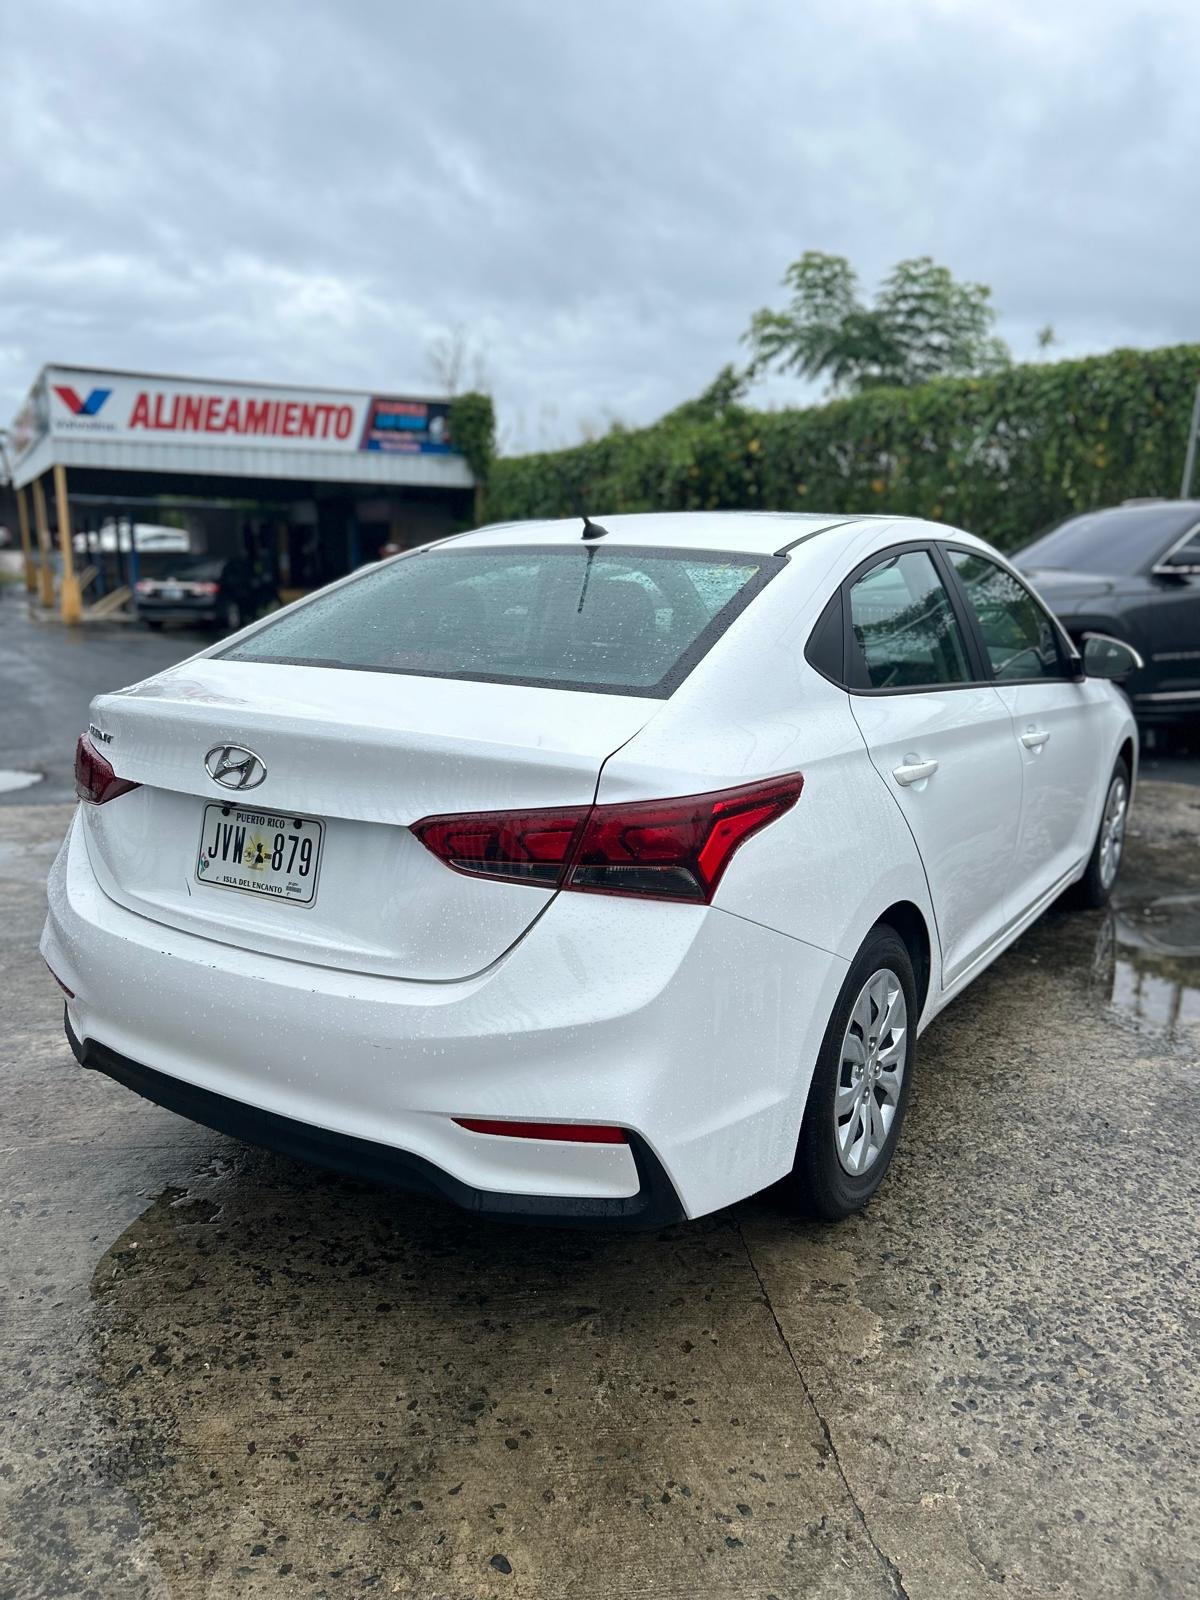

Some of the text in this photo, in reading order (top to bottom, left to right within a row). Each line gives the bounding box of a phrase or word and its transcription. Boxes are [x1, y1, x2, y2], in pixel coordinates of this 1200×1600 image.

[128, 392, 354, 440] ALINEAMIENTO
[236, 812, 285, 829] PUERTO RICO
[207, 822, 313, 877] JVW 879
[223, 875, 237, 885] ISLA
[238, 878, 251, 888] DEL
[252, 882, 283, 894] ENCANTO
